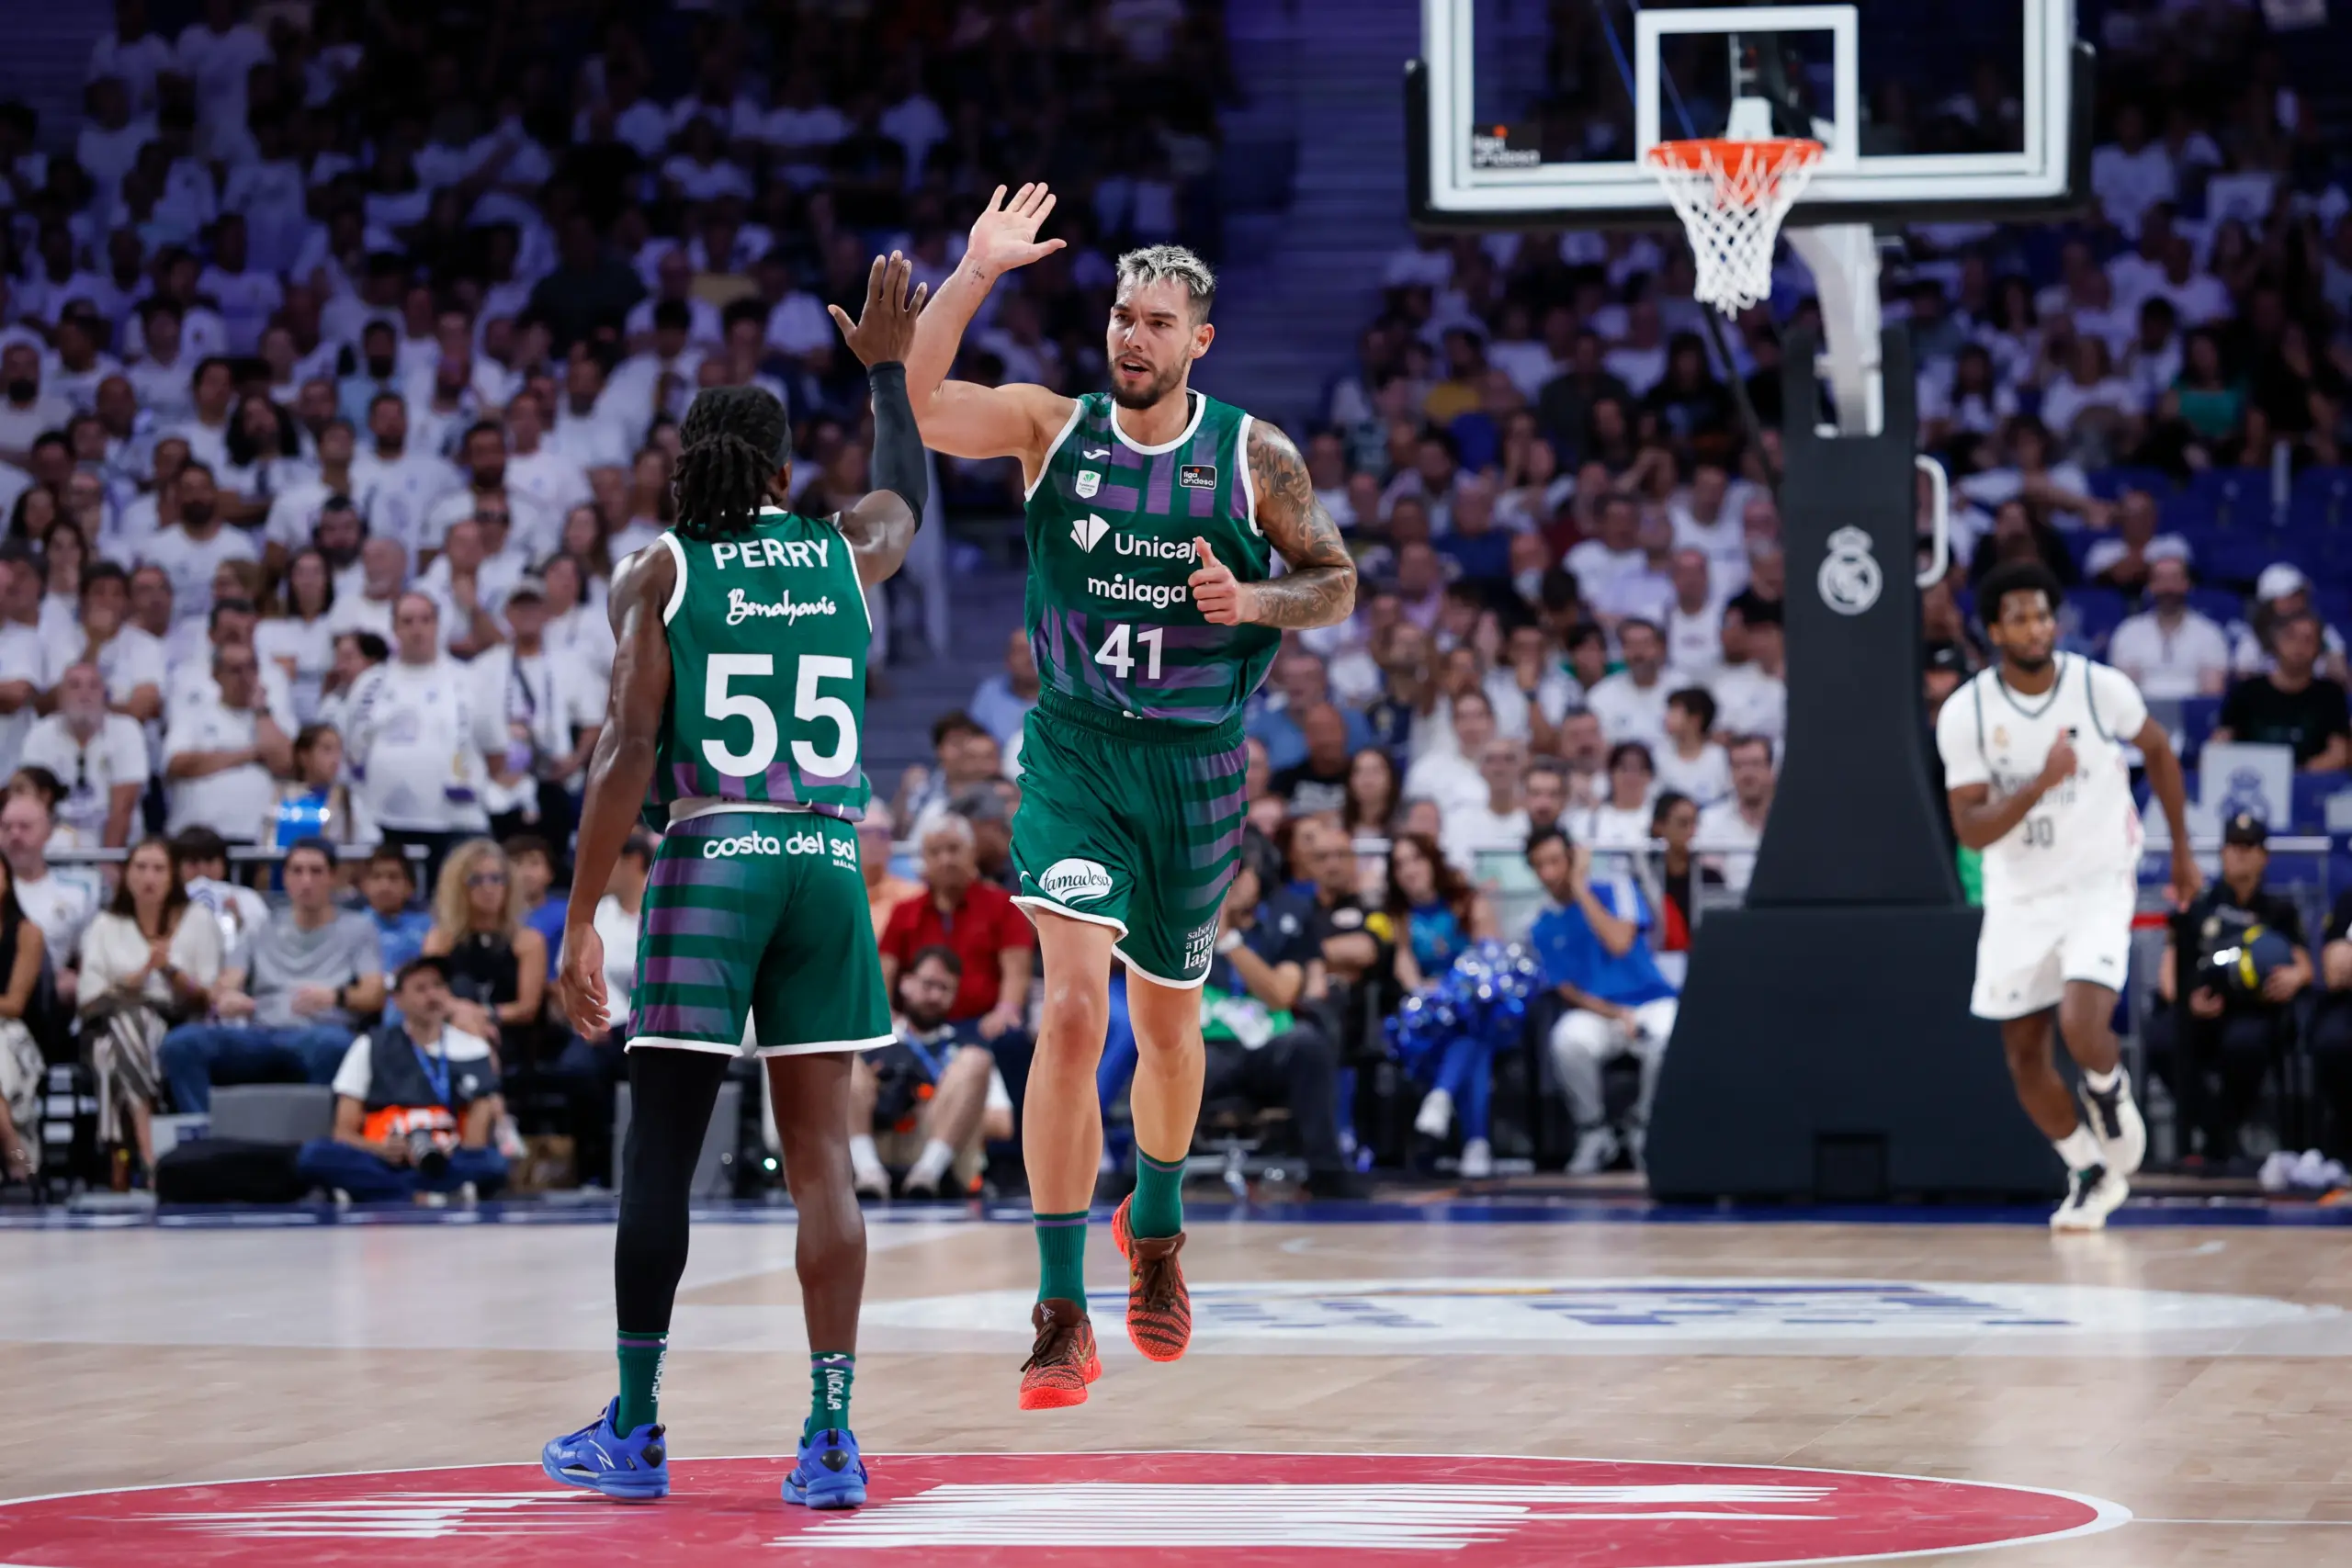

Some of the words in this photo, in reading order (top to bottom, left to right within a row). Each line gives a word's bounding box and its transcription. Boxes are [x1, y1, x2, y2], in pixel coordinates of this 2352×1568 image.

[1183, 471, 1198, 479] liga
[1183, 478, 1214, 486] endesa
[711, 538, 829, 570] PERRY
[1094, 624, 1163, 680] 41
[701, 653, 858, 777] 55
[703, 830, 781, 860] costa
[786, 831, 825, 855] del
[830, 838, 856, 863] sol
[1044, 865, 1109, 891] famadesa
[1187, 922, 1211, 940] sabor
[1185, 942, 1192, 950] a
